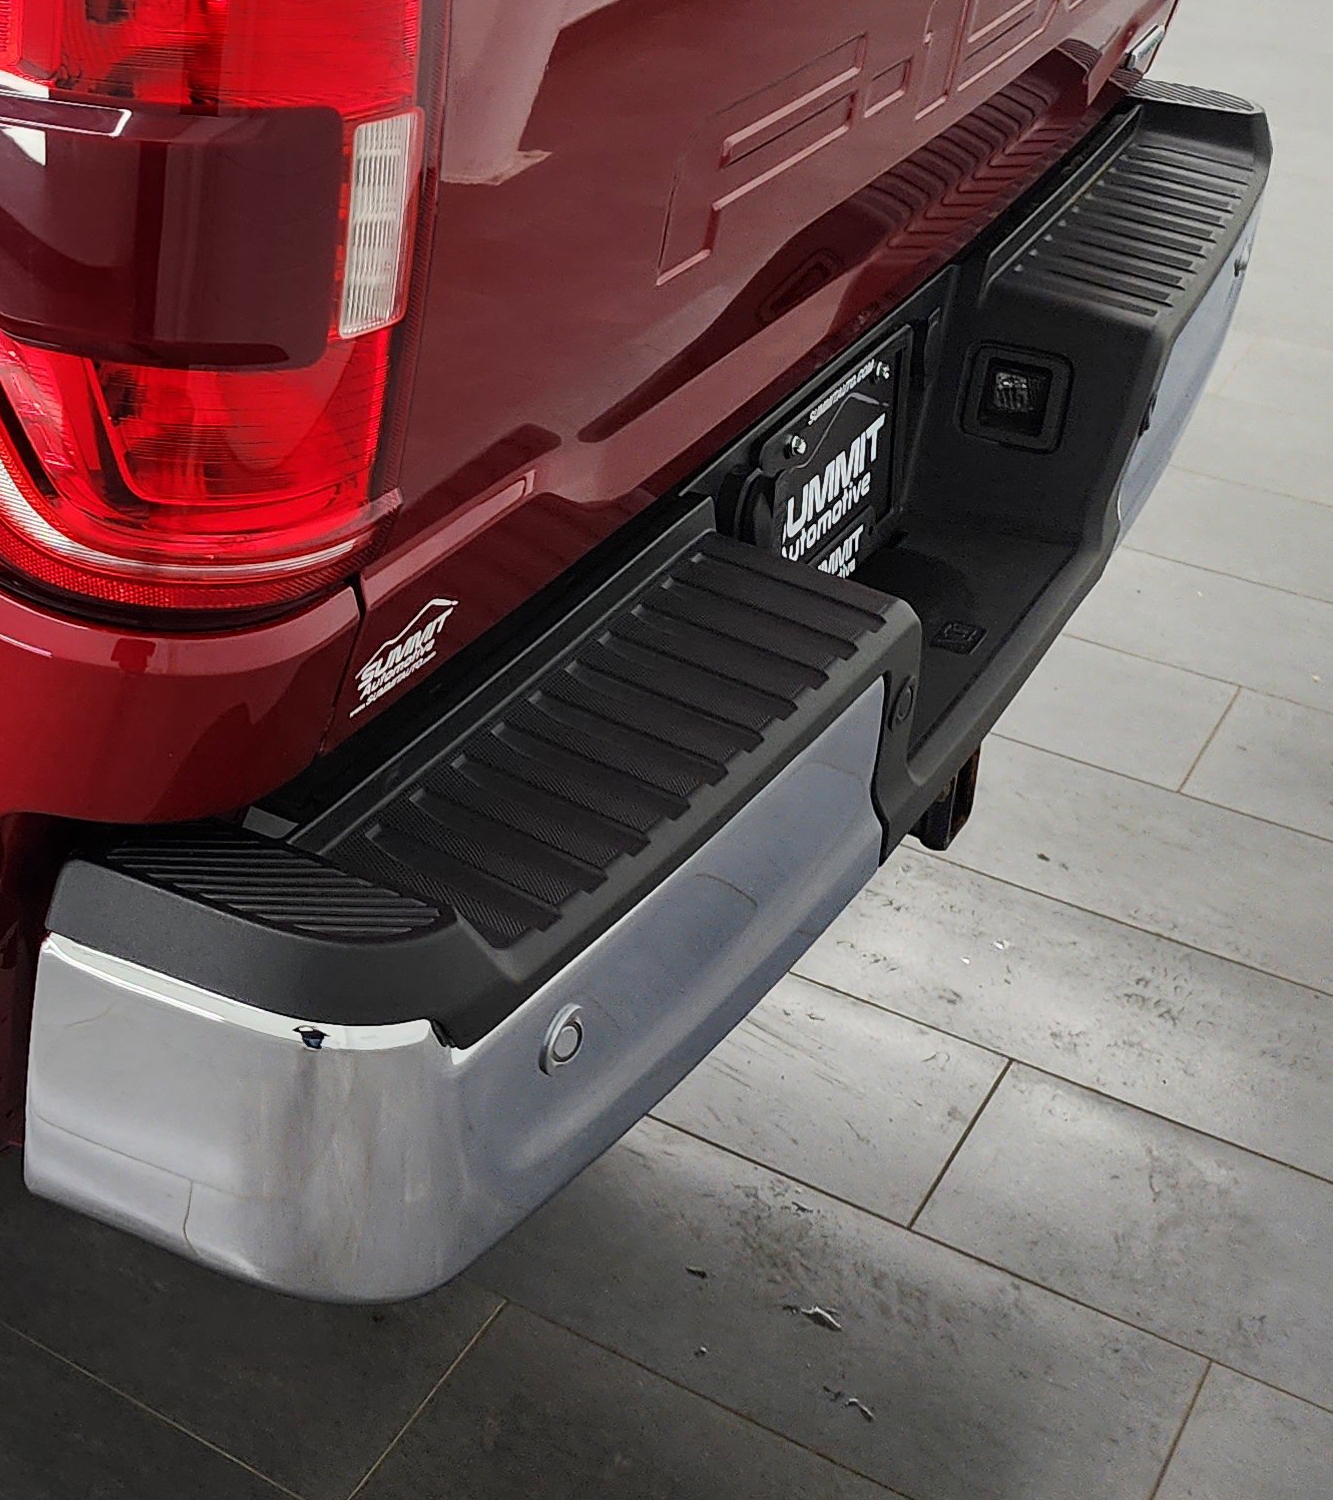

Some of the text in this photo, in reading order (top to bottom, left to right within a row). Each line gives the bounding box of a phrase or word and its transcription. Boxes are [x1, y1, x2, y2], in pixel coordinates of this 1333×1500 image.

[781, 412, 886, 545] UMMIT
[356, 606, 454, 691] SUMMIT
[359, 637, 436, 701] Automotive
